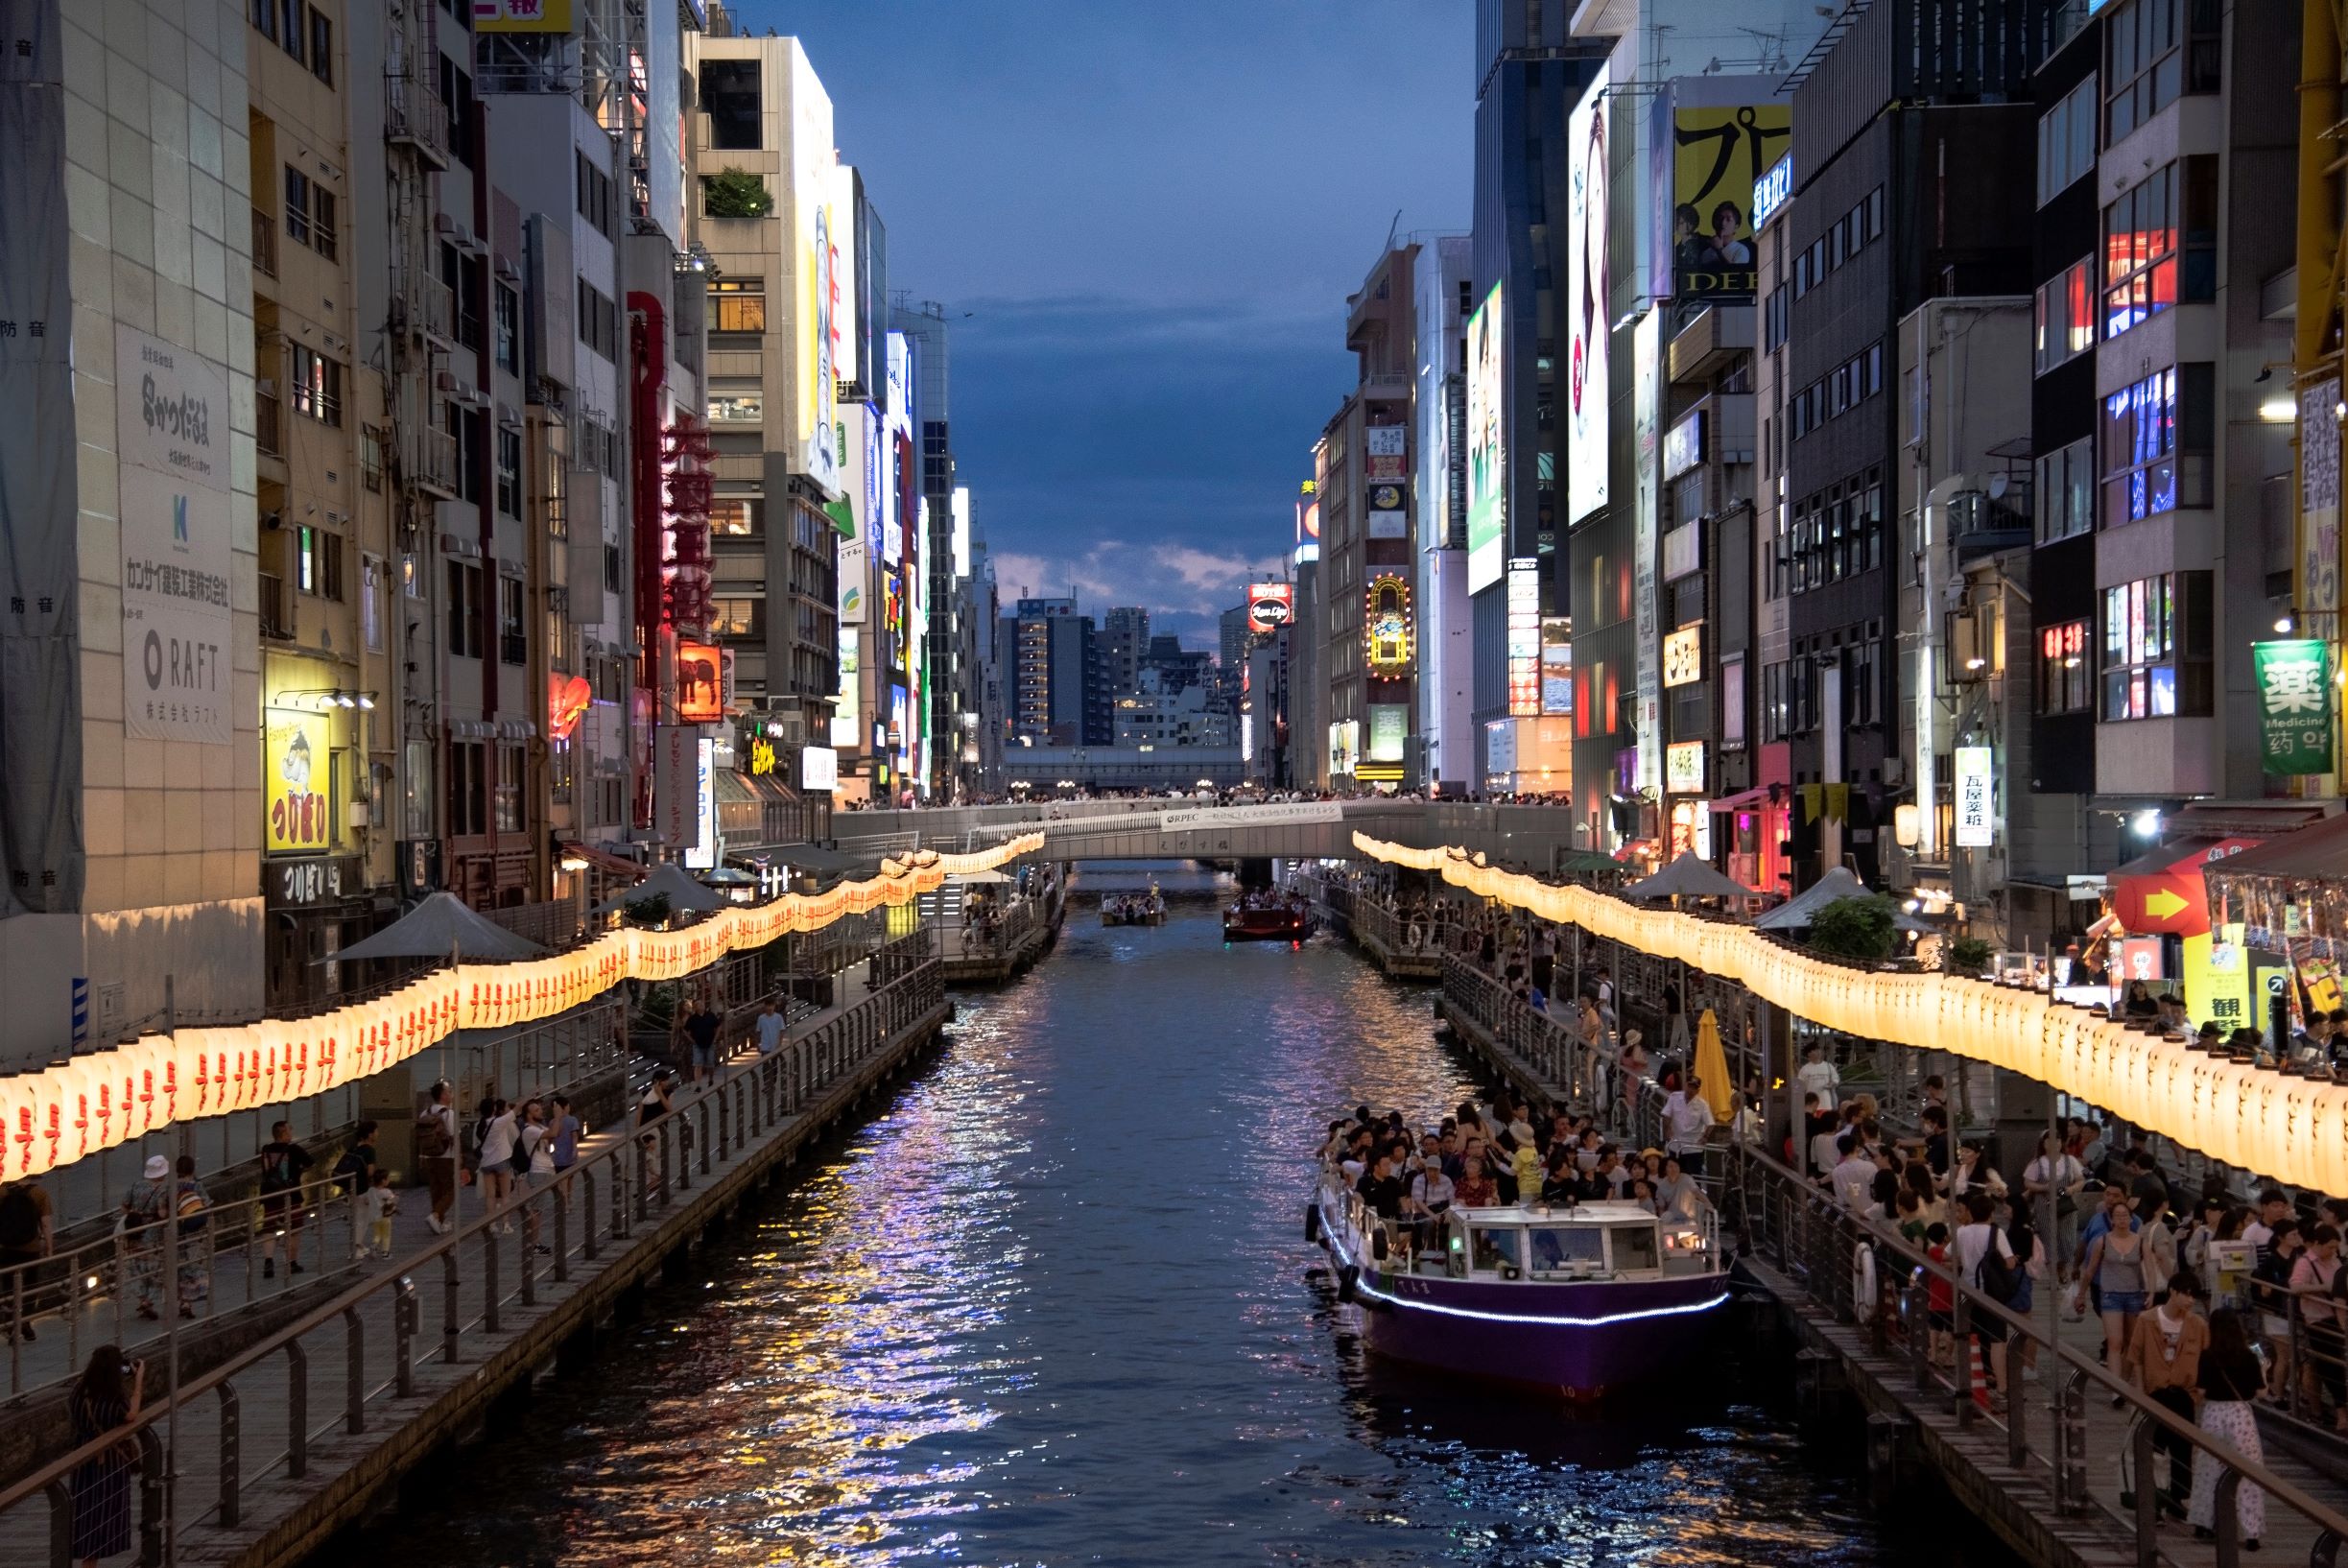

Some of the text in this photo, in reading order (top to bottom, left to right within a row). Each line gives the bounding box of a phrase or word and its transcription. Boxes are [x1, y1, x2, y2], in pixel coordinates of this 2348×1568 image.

[142, 371, 209, 447] 串かつだるま
[11, 594, 54, 614] 防音
[171, 637, 218, 691] RAFT
[2263, 659, 2323, 713] 薬
[147, 701, 218, 725] 株式会社ラフト
[2265, 716, 2326, 728] Medicine
[2266, 730, 2293, 753] 药
[273, 792, 325, 843] つりぼり
[1965, 774, 1983, 825] 瓦屋薬粧
[13, 869, 57, 888] 防音
